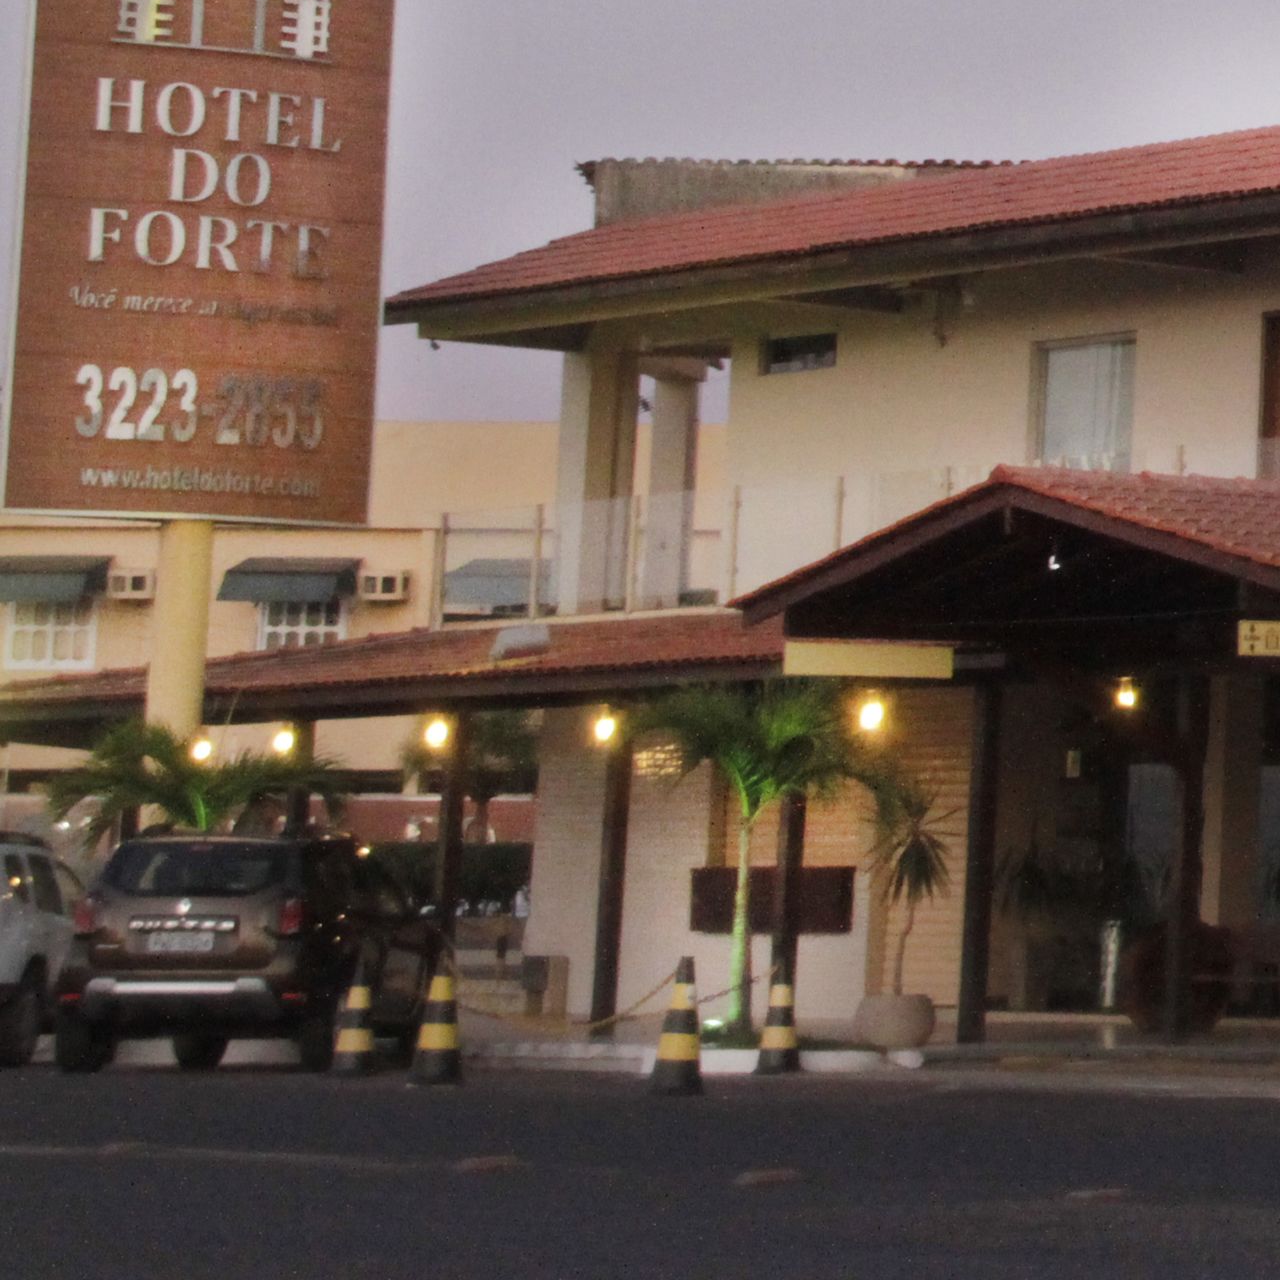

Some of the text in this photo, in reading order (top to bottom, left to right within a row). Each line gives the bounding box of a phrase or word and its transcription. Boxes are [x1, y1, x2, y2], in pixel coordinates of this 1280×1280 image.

[95, 77, 342, 153] HOTEL
[168, 148, 271, 206] DO
[87, 207, 331, 280] FORTE
